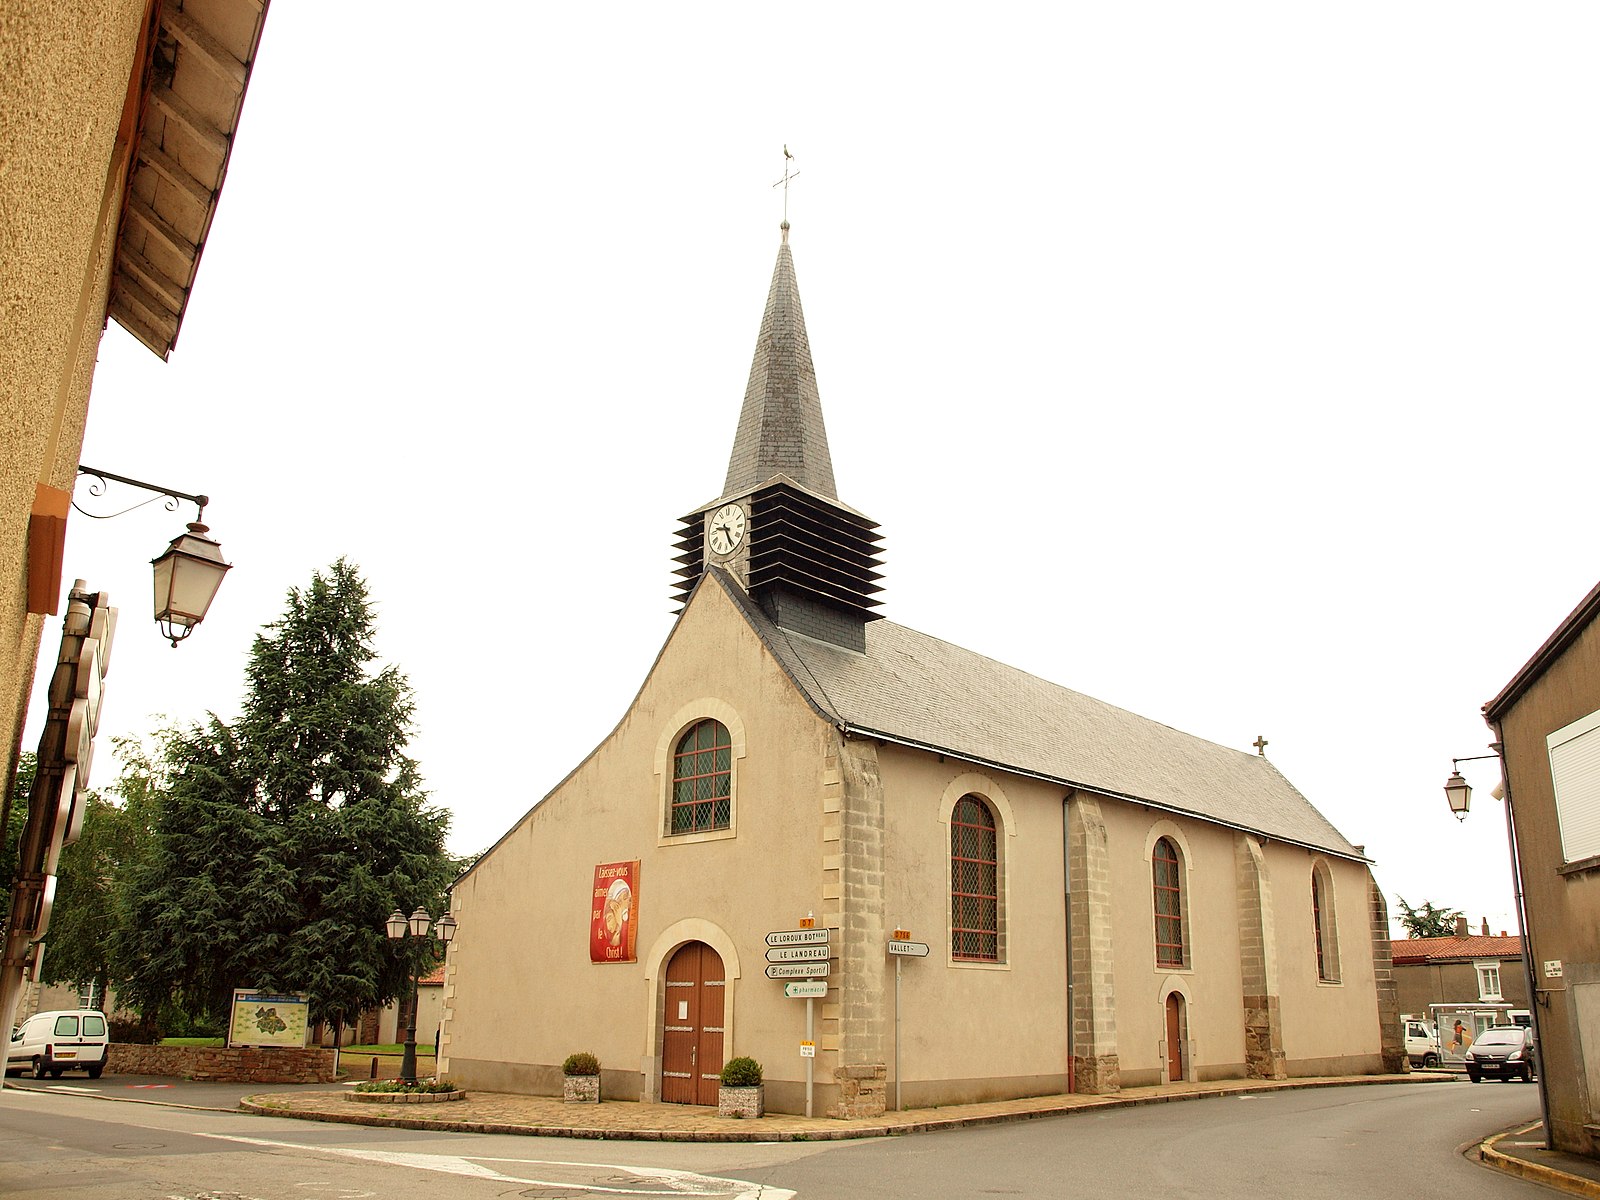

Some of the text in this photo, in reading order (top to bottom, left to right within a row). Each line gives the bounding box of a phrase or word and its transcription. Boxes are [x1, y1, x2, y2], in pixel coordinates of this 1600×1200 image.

[599, 866, 628, 878] Laissez-vous
[593, 909, 601, 920] par
[771, 935, 778, 943] LE
[779, 933, 802, 943] LOROUX
[890, 944, 910, 952] VALLET
[791, 949, 827, 958] LANDREAU
[778, 967, 804, 977] Complexe
[806, 966, 826, 976] Sportif
[799, 986, 825, 994] pharmacie
